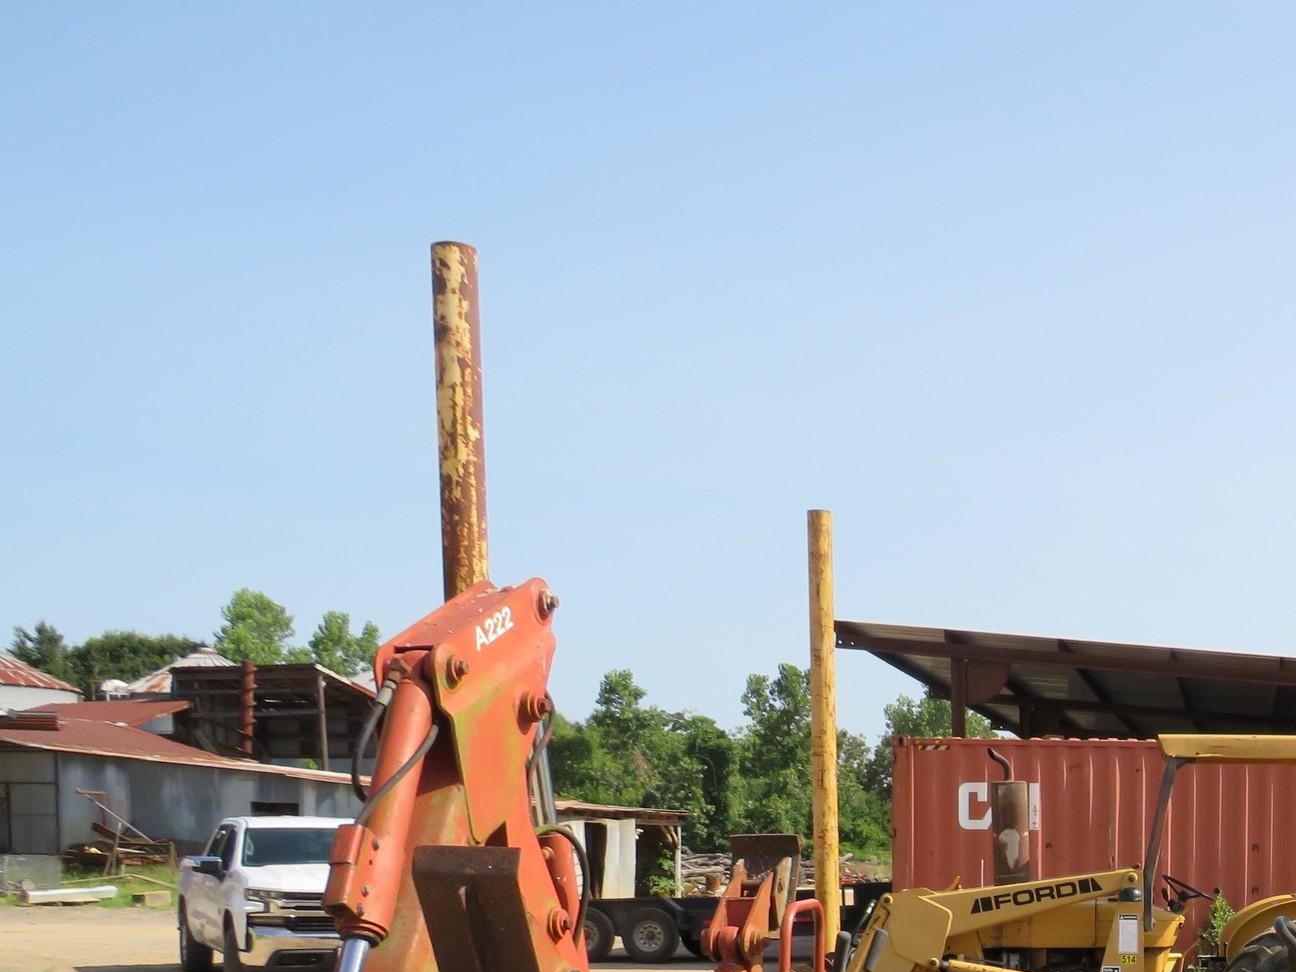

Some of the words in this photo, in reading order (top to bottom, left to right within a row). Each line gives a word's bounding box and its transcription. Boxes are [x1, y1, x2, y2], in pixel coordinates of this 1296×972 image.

[475, 606, 514, 652] A222
[993, 881, 1078, 910] FORD
[1121, 955, 1136, 964] 514
